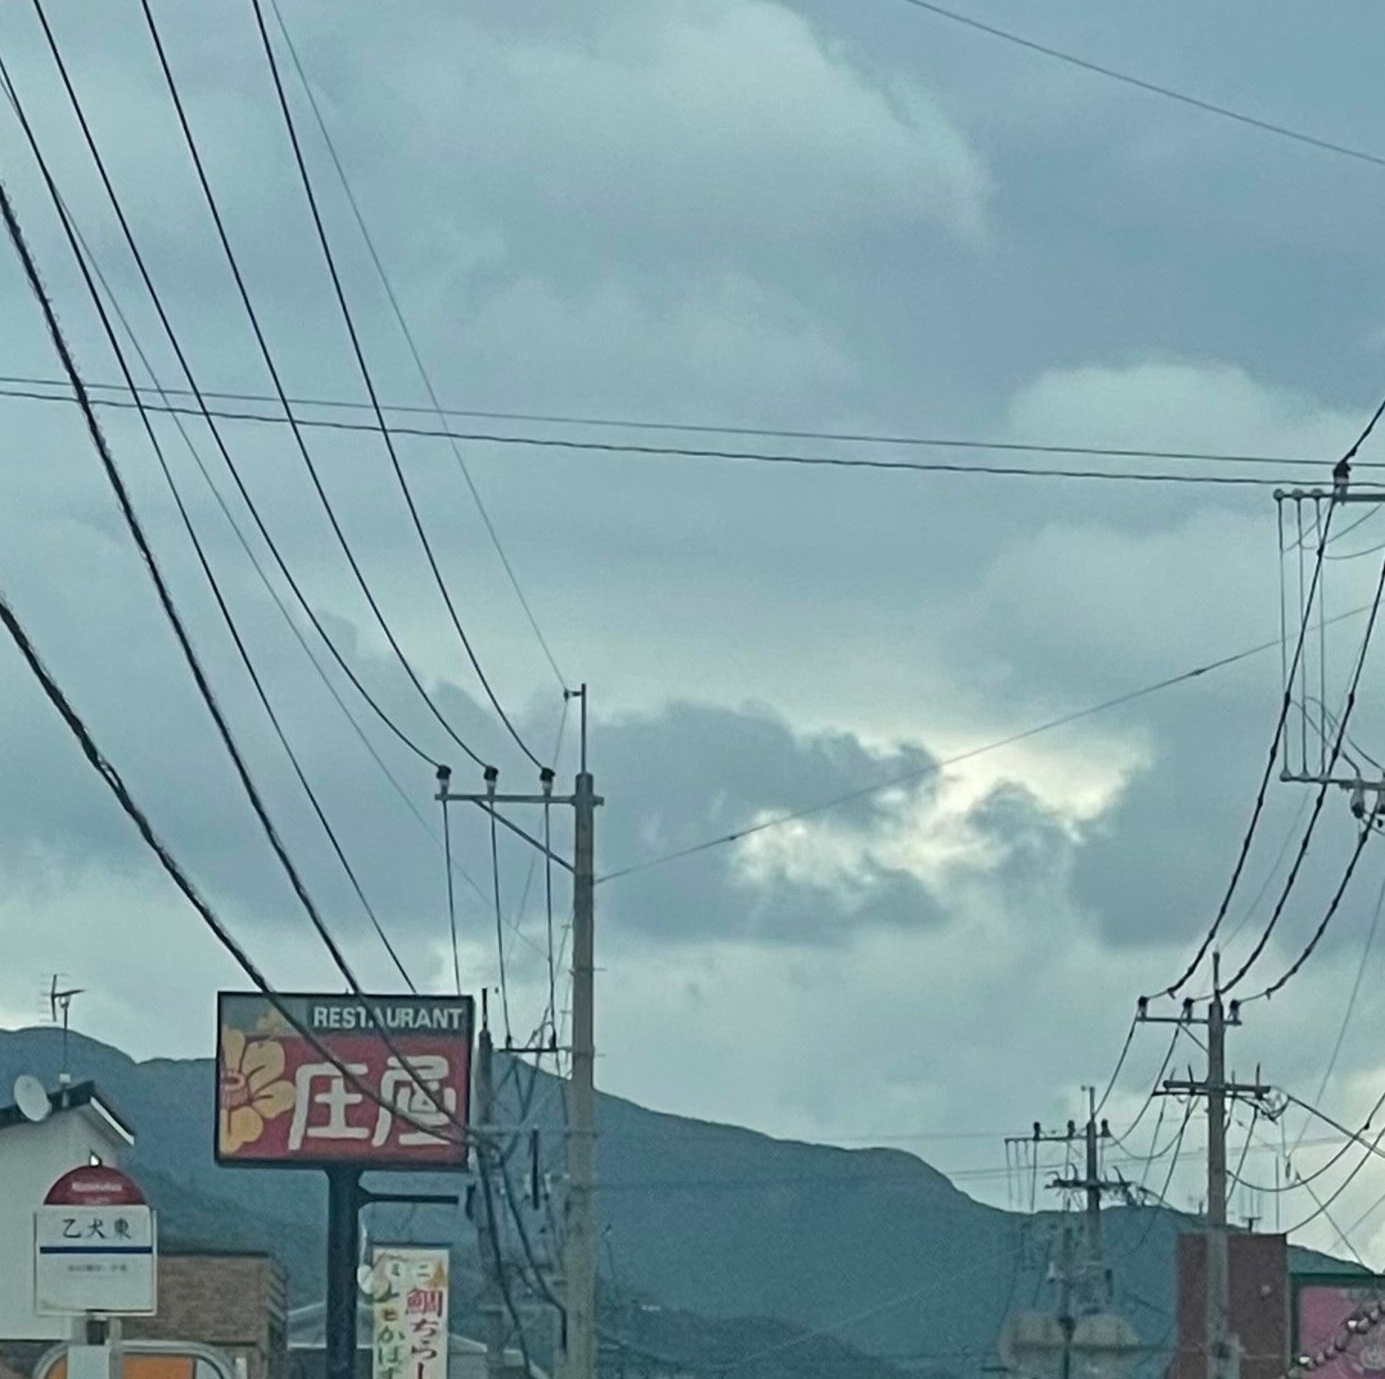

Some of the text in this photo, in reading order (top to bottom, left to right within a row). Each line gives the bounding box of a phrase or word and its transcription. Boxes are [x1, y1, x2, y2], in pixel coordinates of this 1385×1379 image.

[288, 1055, 457, 1151] 庄屋
[62, 1217, 132, 1239] 乙犬東
